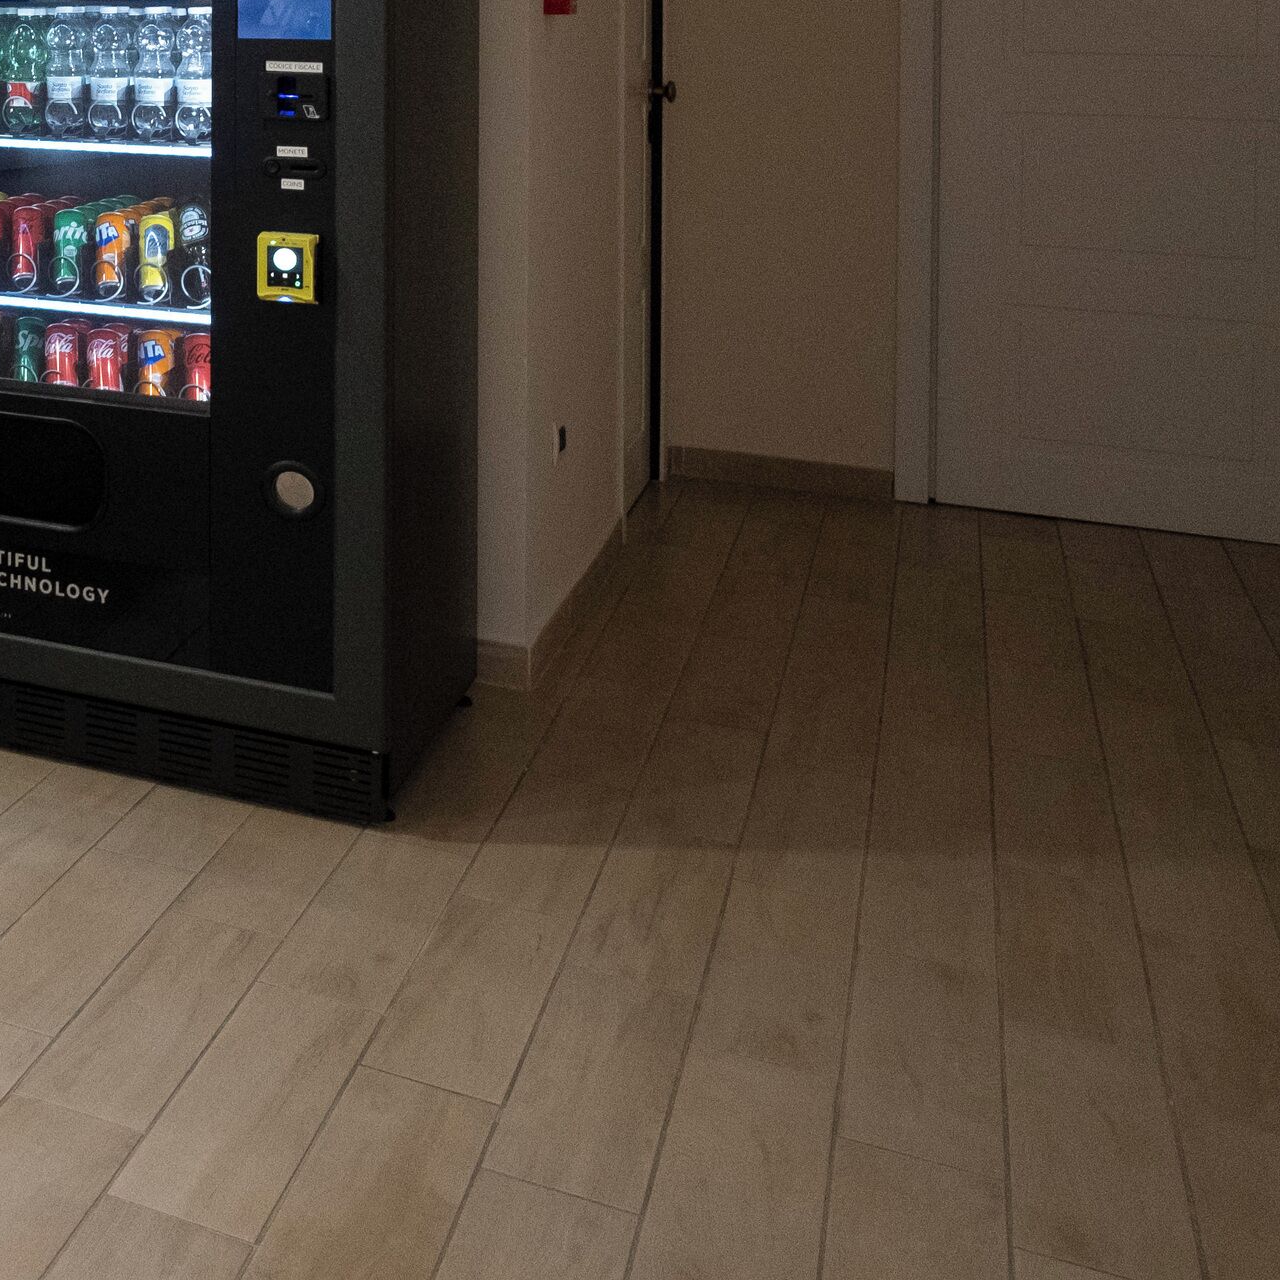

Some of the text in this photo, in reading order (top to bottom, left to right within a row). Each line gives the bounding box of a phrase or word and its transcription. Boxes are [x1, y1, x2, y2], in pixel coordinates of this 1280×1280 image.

[294, 63, 321, 71] FISCALE
[278, 147, 307, 156] MONETE
[282, 180, 303, 189] COINS
